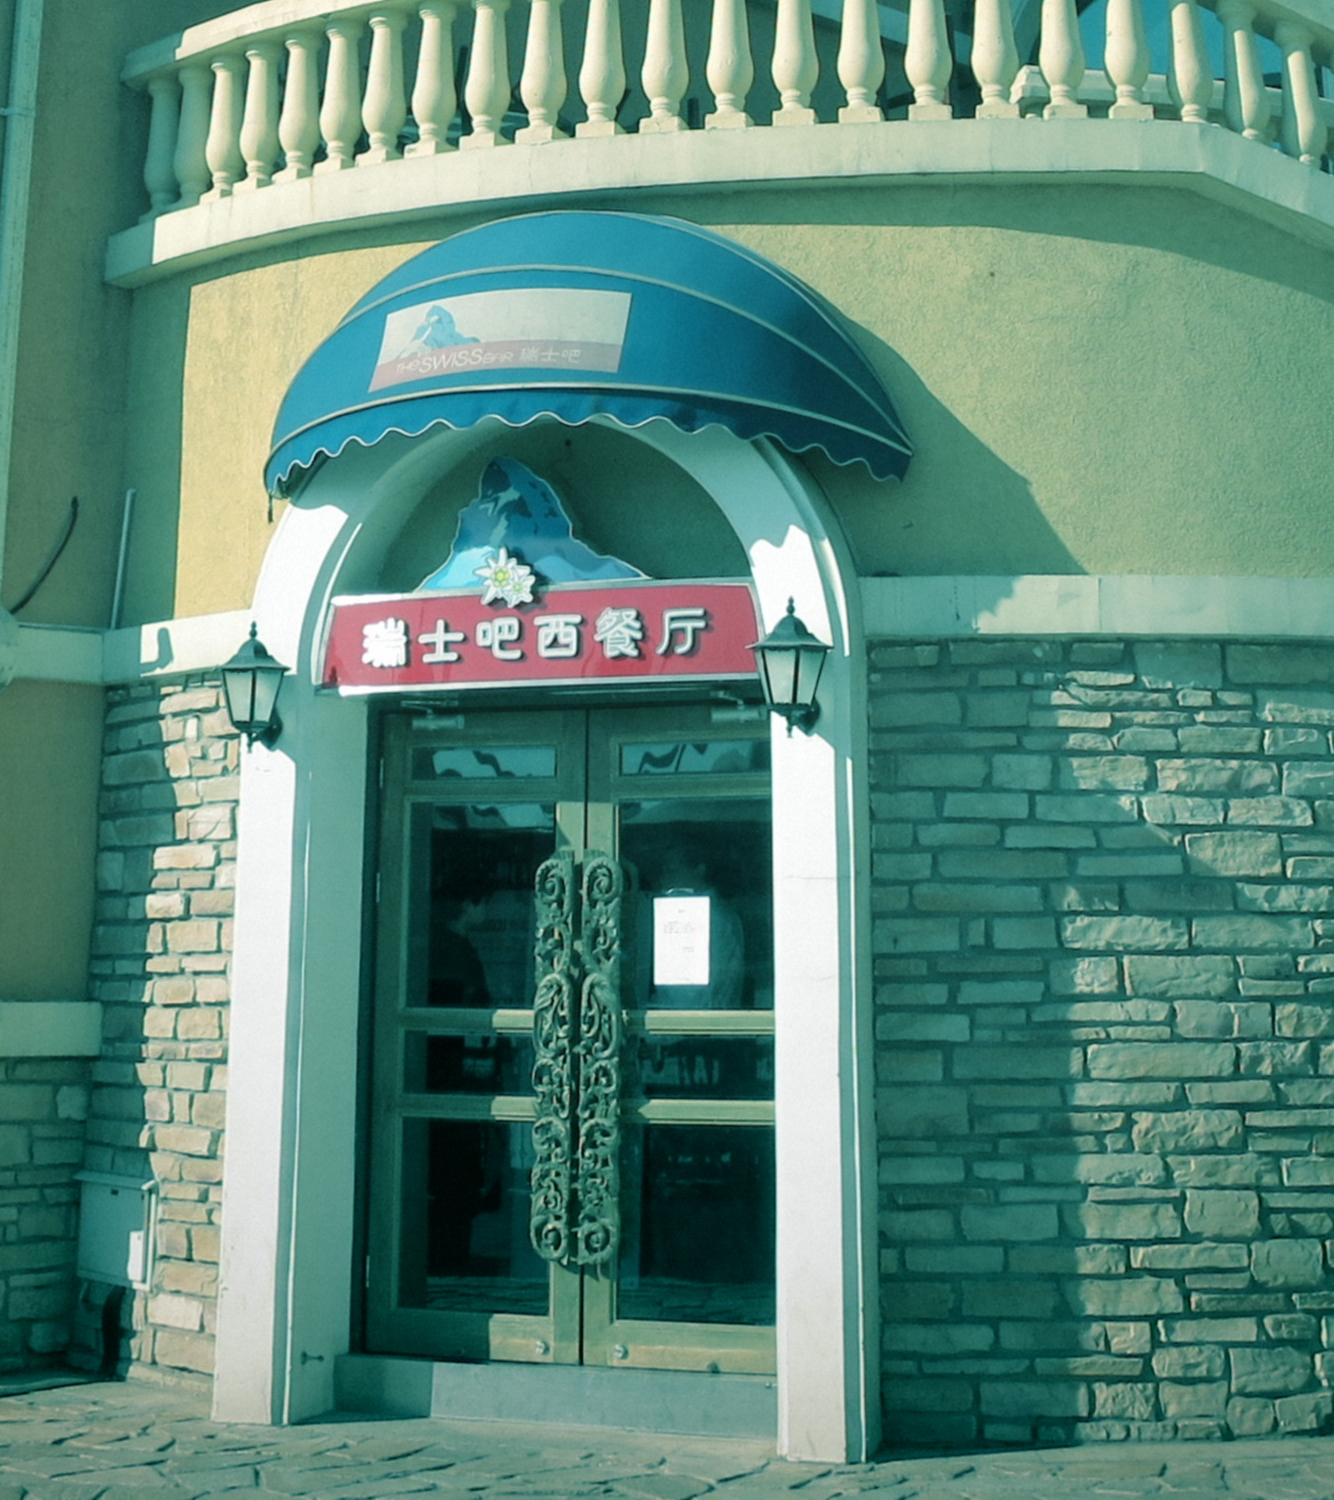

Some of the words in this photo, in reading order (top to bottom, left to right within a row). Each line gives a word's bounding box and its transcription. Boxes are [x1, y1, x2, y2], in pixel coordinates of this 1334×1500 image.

[419, 348, 483, 373] SWISS
[519, 346, 581, 364] 瑞士吧
[361, 607, 708, 668] 瑞士吧西餐厅
